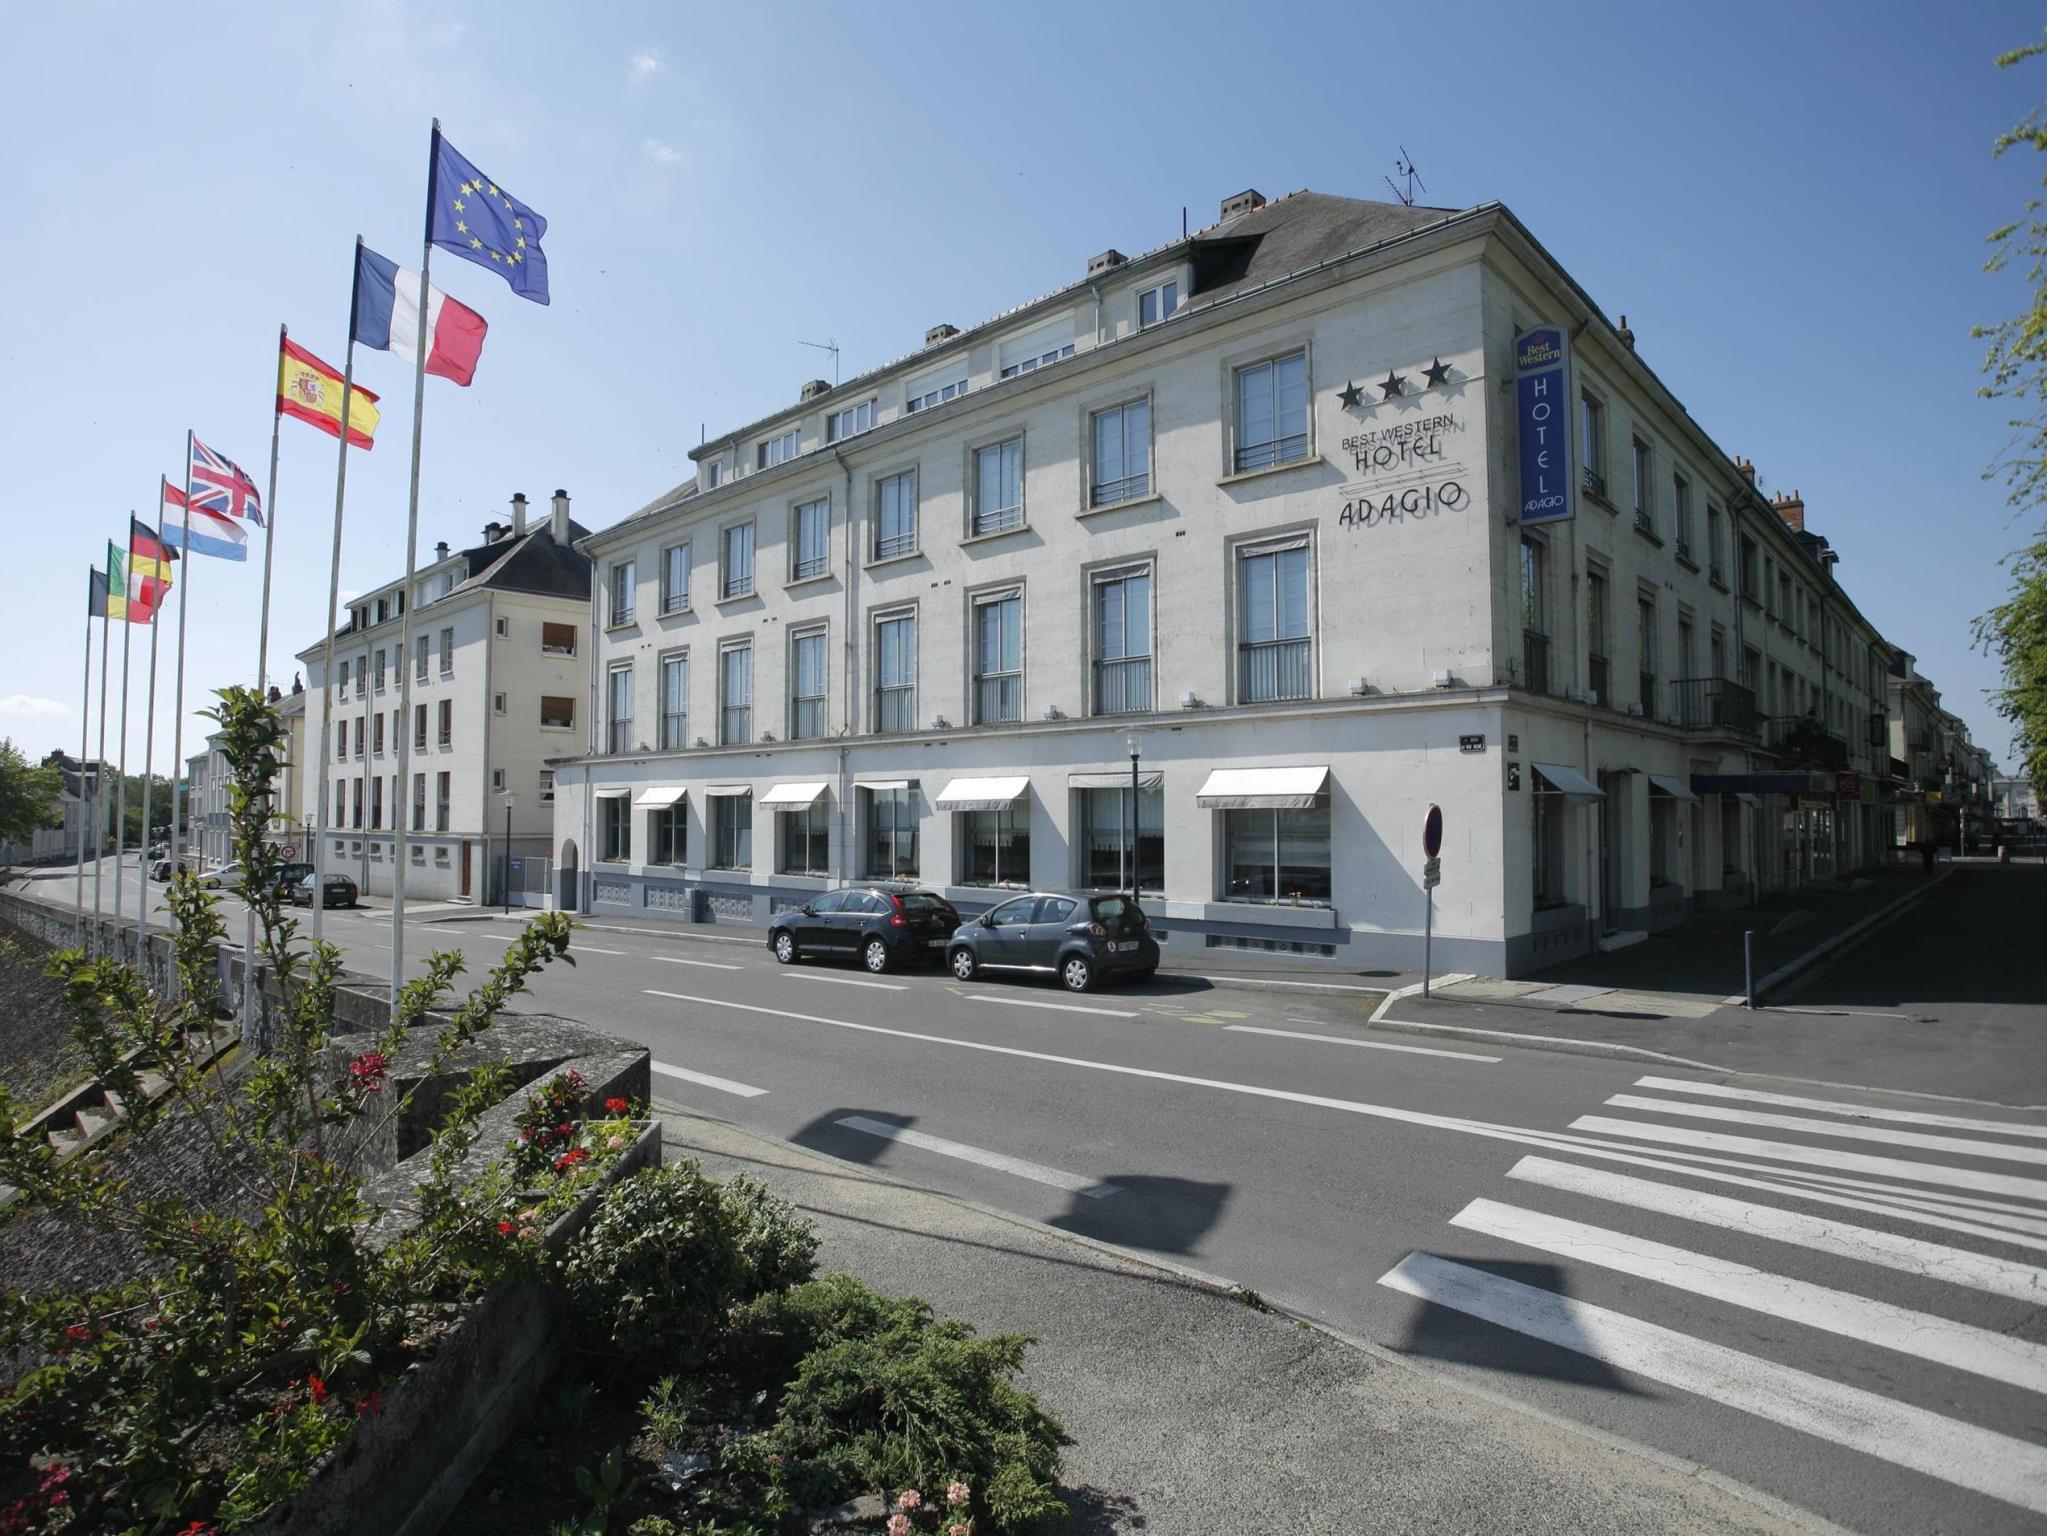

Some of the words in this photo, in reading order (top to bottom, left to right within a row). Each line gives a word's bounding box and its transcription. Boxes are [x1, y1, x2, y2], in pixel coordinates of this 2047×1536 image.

[1519, 349, 1560, 365] Western
[1528, 342, 1550, 356] Best
[1342, 432, 1377, 450] BEST
[1381, 413, 1454, 440] WESTERN
[1532, 378, 1550, 494] HOTEL
[1356, 435, 1440, 471] HOTEL
[1339, 482, 1461, 525] ADAGIO
[1525, 495, 1564, 512] ADAGIO
